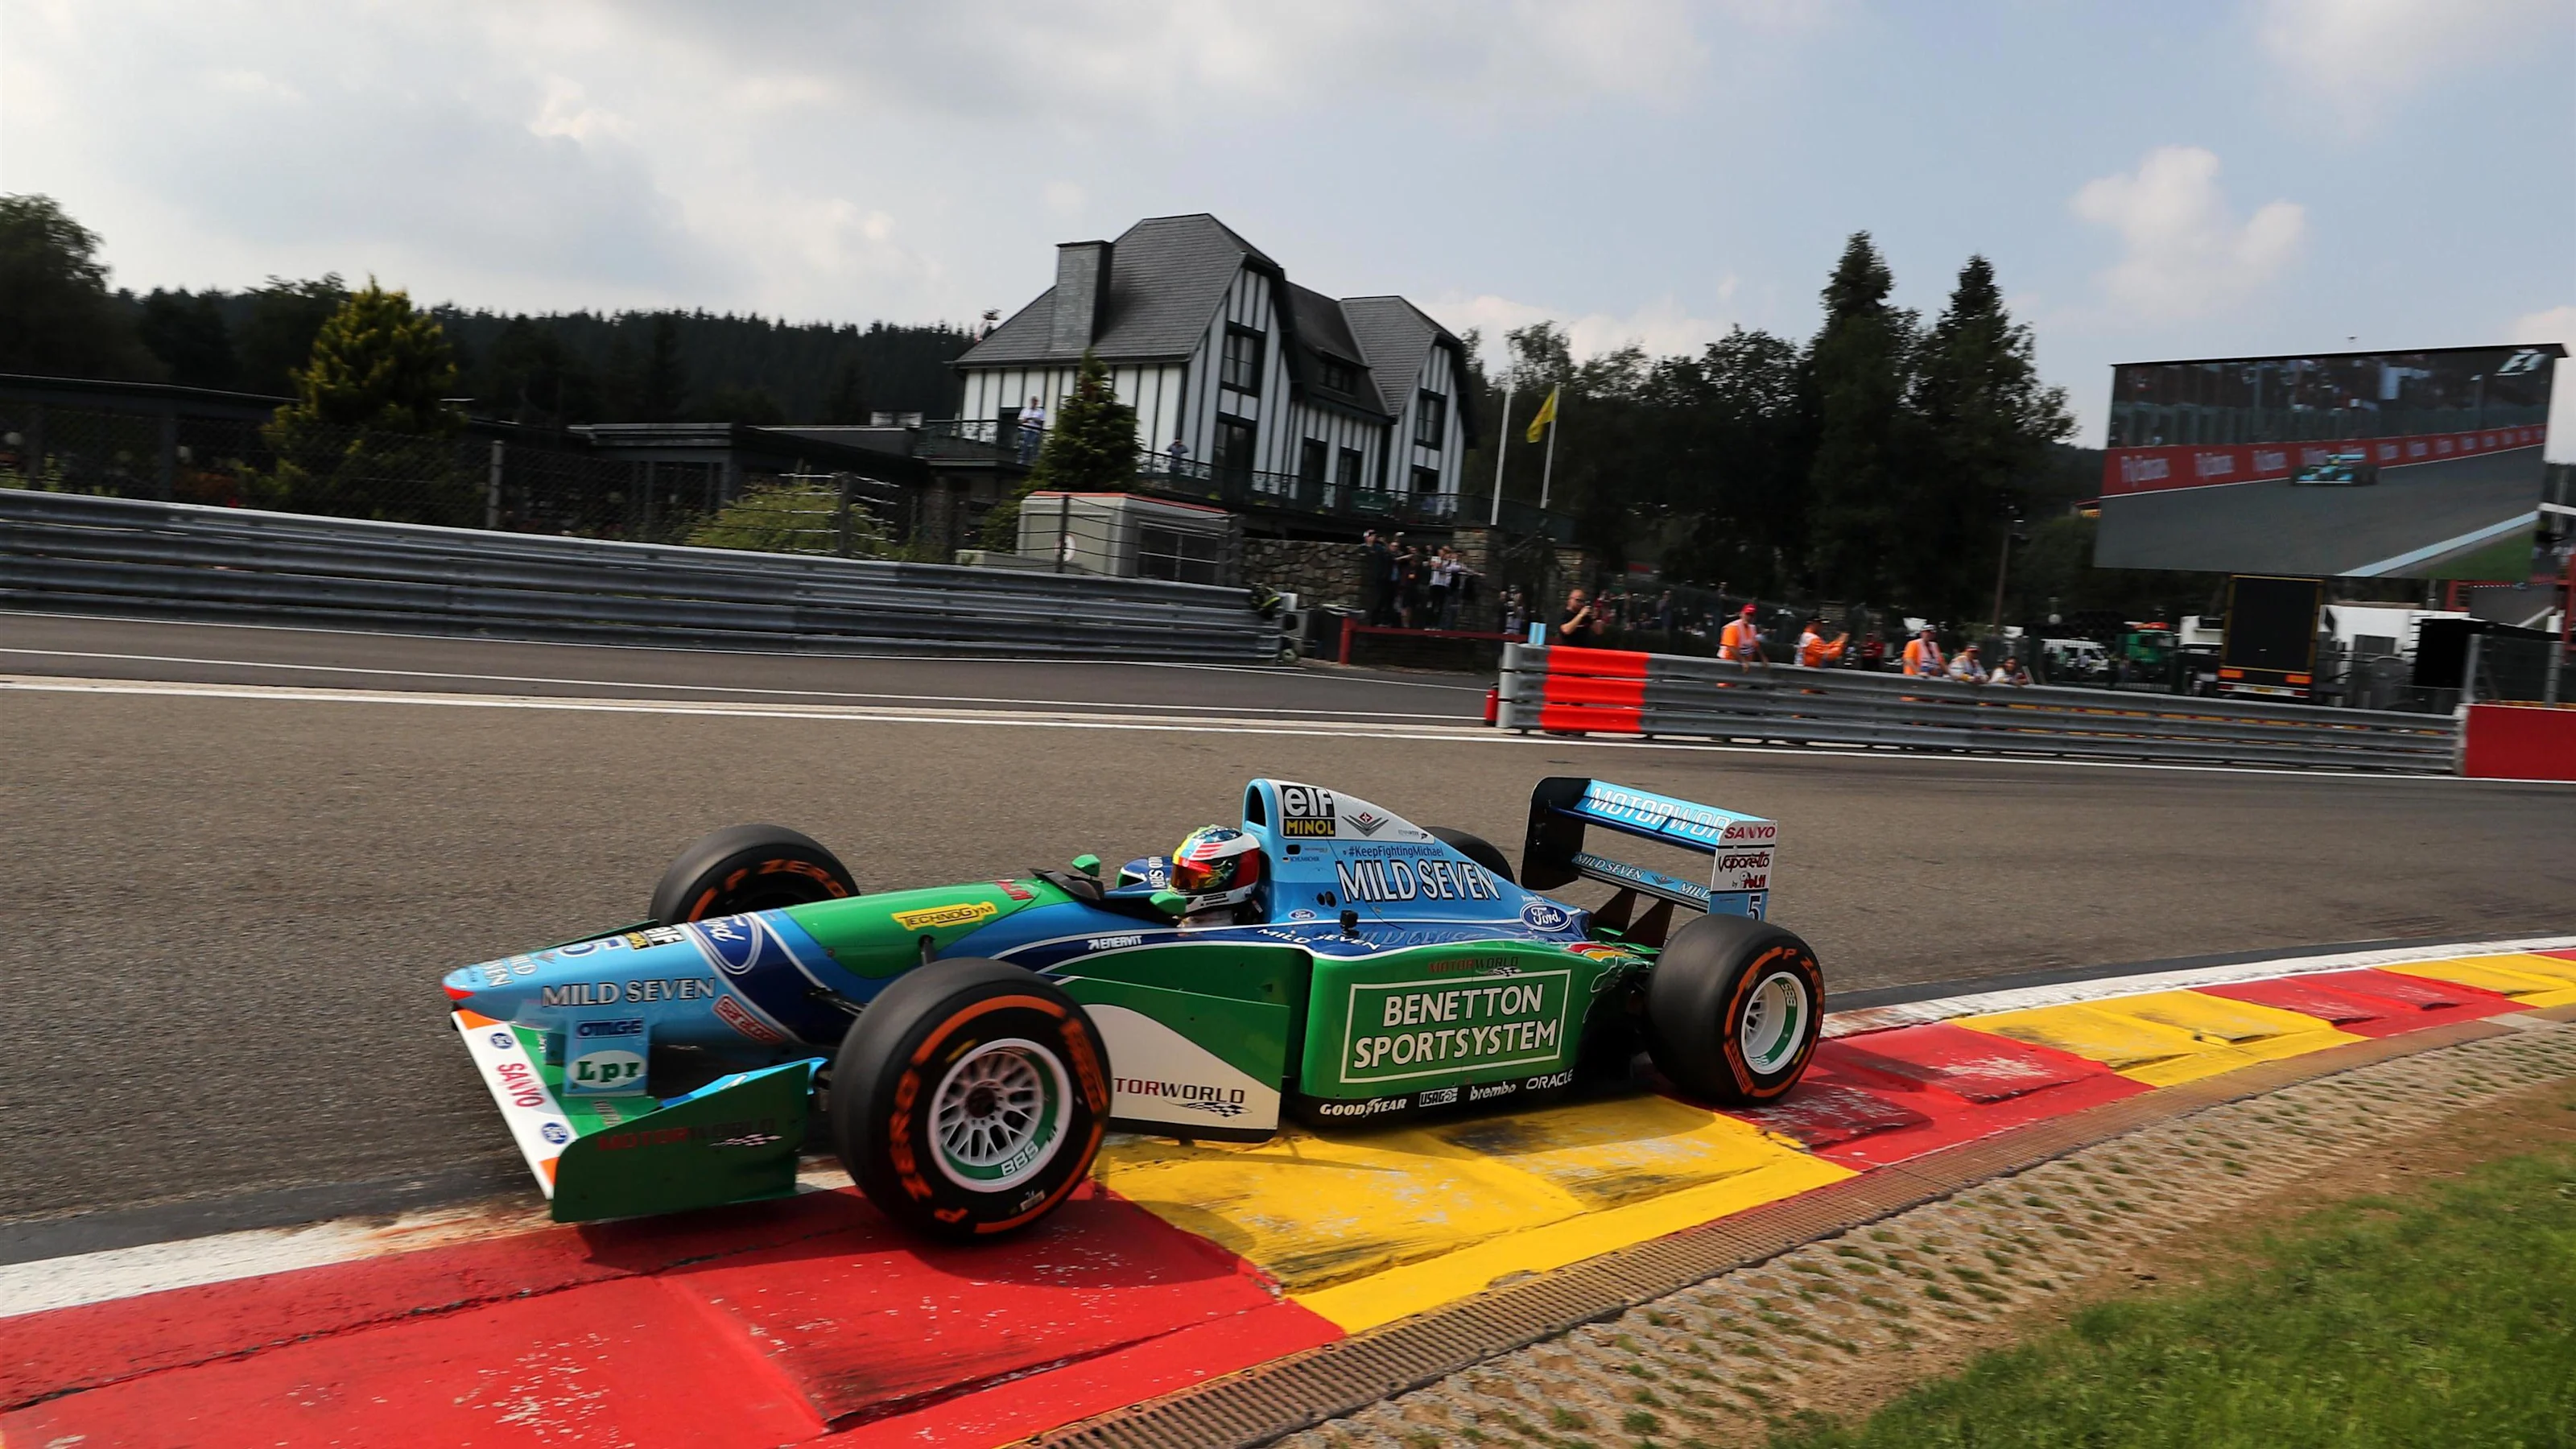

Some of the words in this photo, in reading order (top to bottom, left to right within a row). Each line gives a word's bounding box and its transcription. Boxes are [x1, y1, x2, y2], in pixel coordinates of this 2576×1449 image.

[1284, 787, 1333, 818] elf
[1584, 786, 1733, 841] MOTORWOR
[1286, 819, 1335, 836] MINOL
[1724, 826, 1776, 839] SANYO
[1348, 845, 1444, 859] #KeepFightingMichael
[1575, 852, 1606, 869] MILD
[1608, 861, 1645, 880] SEVEN
[1335, 860, 1418, 903] MILD
[1417, 860, 1502, 902] SEVEN
[1679, 882, 1711, 900] MILD
[1294, 911, 1312, 919] Ford
[1531, 906, 1563, 925] Ford
[1747, 893, 1762, 921] 5
[643, 926, 686, 943] elf
[1100, 935, 1143, 949] ENERVIT
[1257, 928, 1312, 944] MILD
[1313, 933, 1383, 952] SEVEN
[1429, 956, 1519, 973] MOTORWORLD
[1781, 947, 1798, 960] P
[540, 980, 621, 1008] MILD
[624, 977, 716, 1003] SEVEN
[1781, 983, 1797, 1007] BBS
[1382, 983, 1544, 1028] BENETTON
[1352, 1018, 1558, 1069] SPORTSYSTEM
[576, 1060, 641, 1083] Lpr
[1525, 1068, 1575, 1090] ORACLE
[495, 1063, 547, 1108] SANYO
[1113, 1077, 1245, 1104] TORWORLD
[1469, 1081, 1517, 1102] brembo
[1420, 1090, 1446, 1106] USAG
[890, 1069, 933, 1202] ZERO
[1000, 1140, 1039, 1177] BBS
